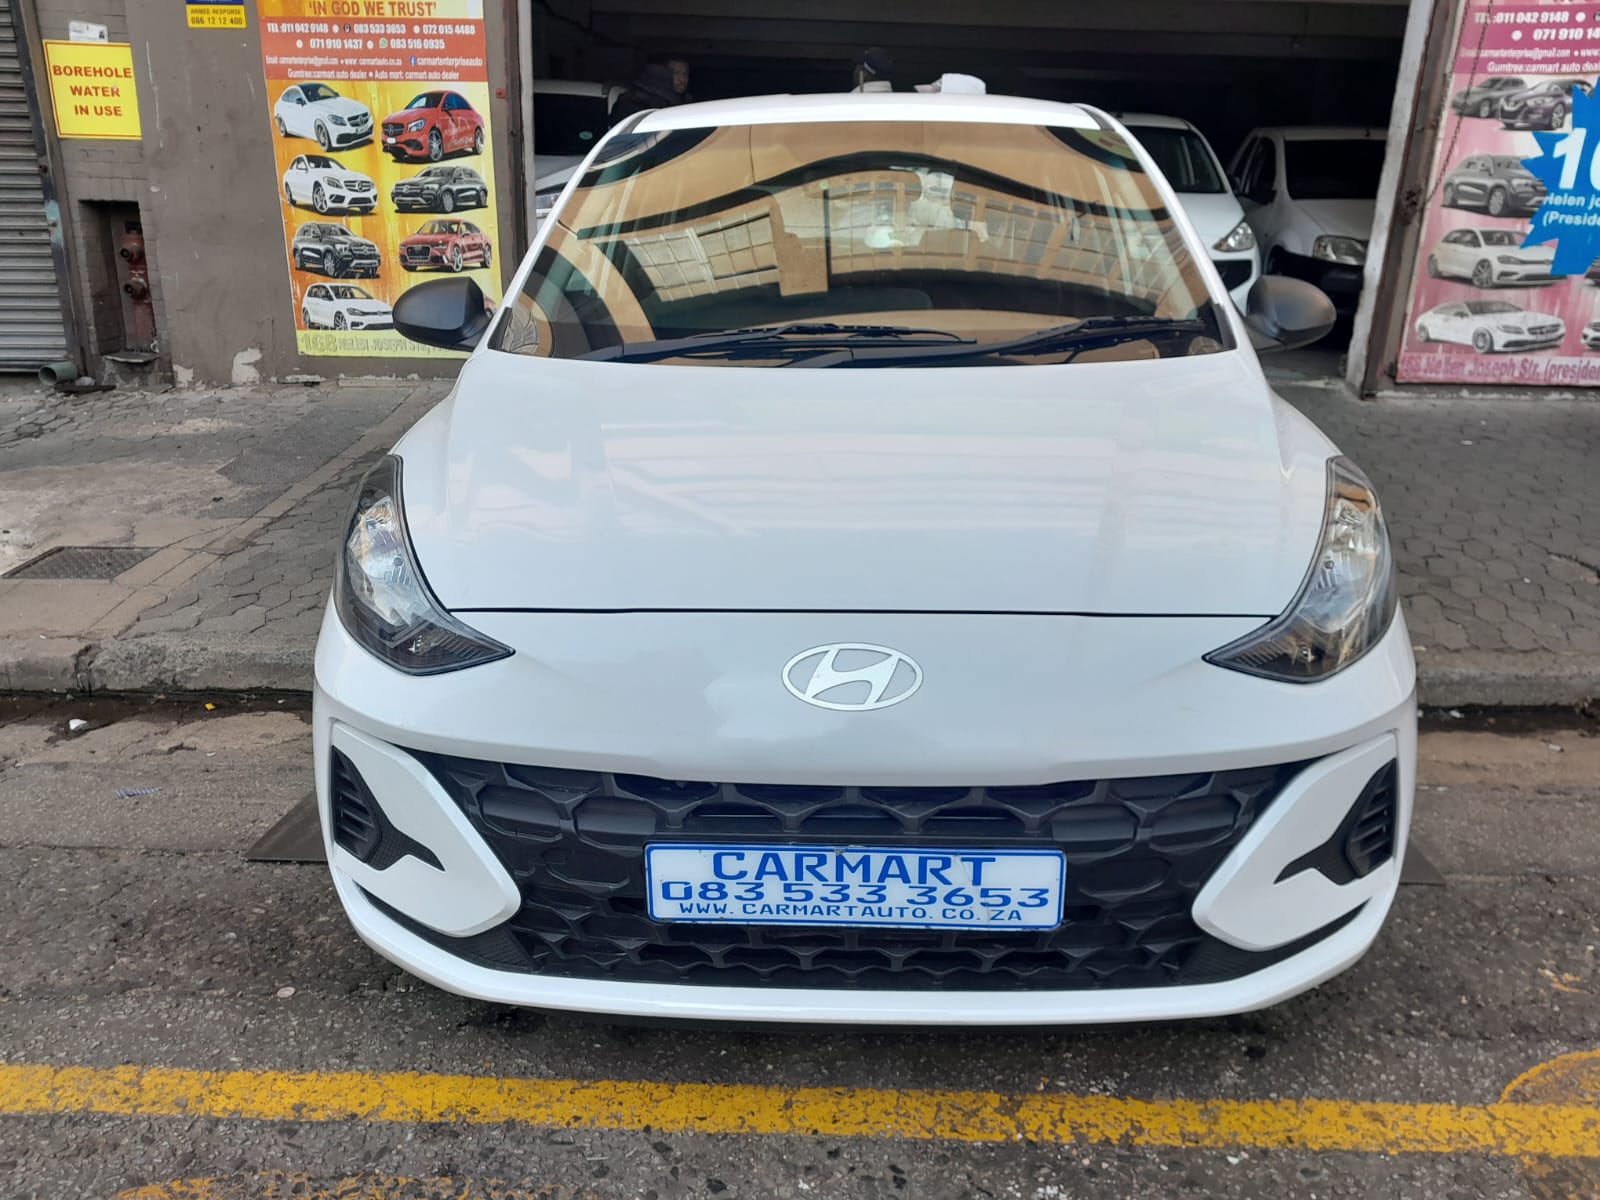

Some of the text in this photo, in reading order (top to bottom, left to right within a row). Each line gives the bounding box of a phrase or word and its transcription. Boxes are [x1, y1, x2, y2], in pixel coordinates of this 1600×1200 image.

[309, 1, 327, 15] 'IN
[331, 1, 360, 16] GOD
[364, 1, 384, 16] WE
[1516, 12, 1538, 23] 042
[1540, 12, 1570, 23] 9148
[310, 23, 328, 33] 9148
[370, 24, 384, 33] 533
[423, 24, 437, 34] 072
[1533, 28, 1556, 40] 071
[1558, 28, 1584, 40] 910
[310, 38, 324, 48] 071
[344, 39, 362, 49] 1437
[53, 65, 132, 78] BOREHOLE
[1560, 62, 1580, 72] auto
[350, 70, 367, 78] dealer
[374, 69, 388, 79] Auto
[442, 70, 459, 80] dealer
[70, 85, 120, 97] WATER
[74, 105, 122, 117] IN USE
[1520, 358, 1540, 378] Str.
[713, 852, 997, 887] CARMART
[661, 881, 1050, 908] 083 533 3653
